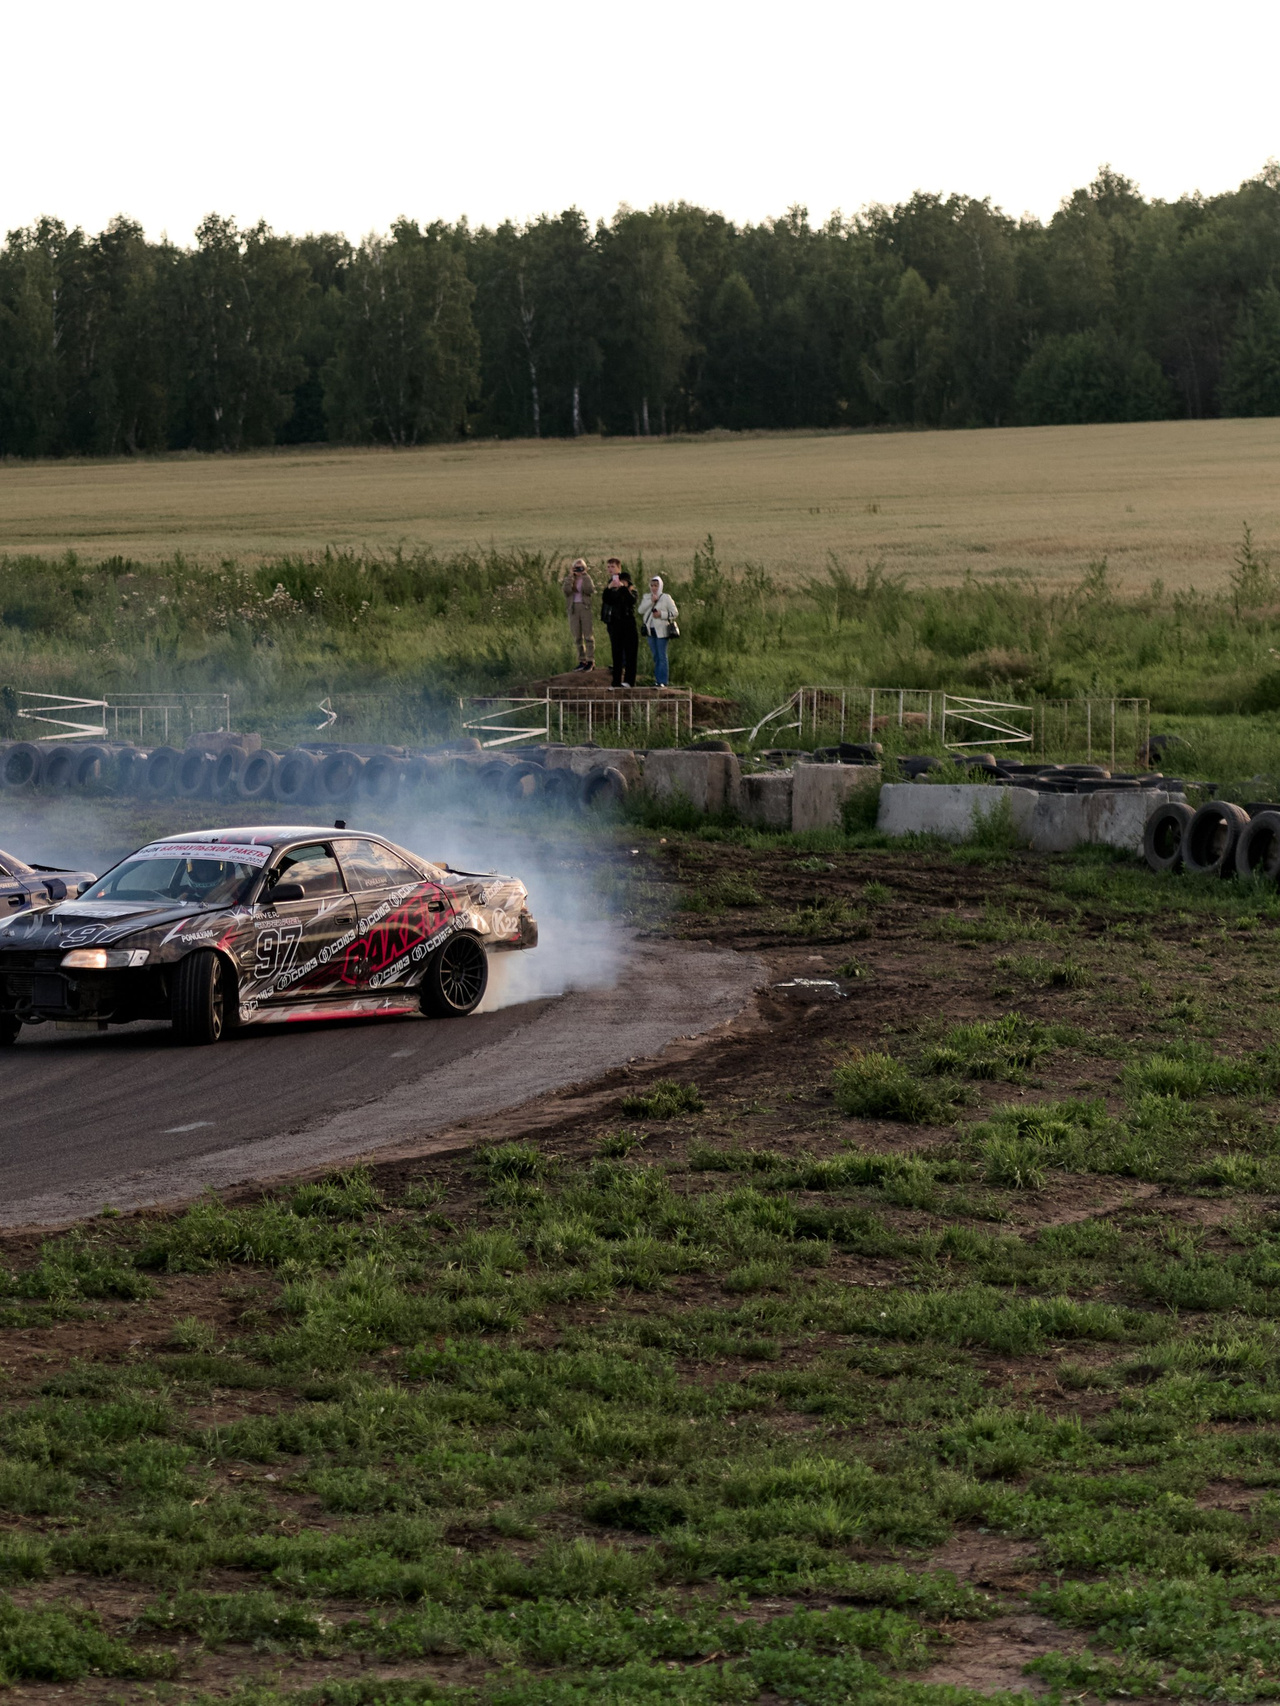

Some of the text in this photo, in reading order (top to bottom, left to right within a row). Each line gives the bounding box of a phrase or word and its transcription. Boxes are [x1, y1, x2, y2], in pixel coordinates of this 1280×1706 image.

[232, 847, 270, 859] РАКЕТЫ
[368, 902, 391, 925] СОЮЗ
[59, 923, 148, 949] 97
[331, 930, 356, 955] СОЮЗ
[254, 924, 302, 979] 97
[291, 957, 319, 982] СОЮЗ
[383, 956, 410, 979] СОЮЗ
